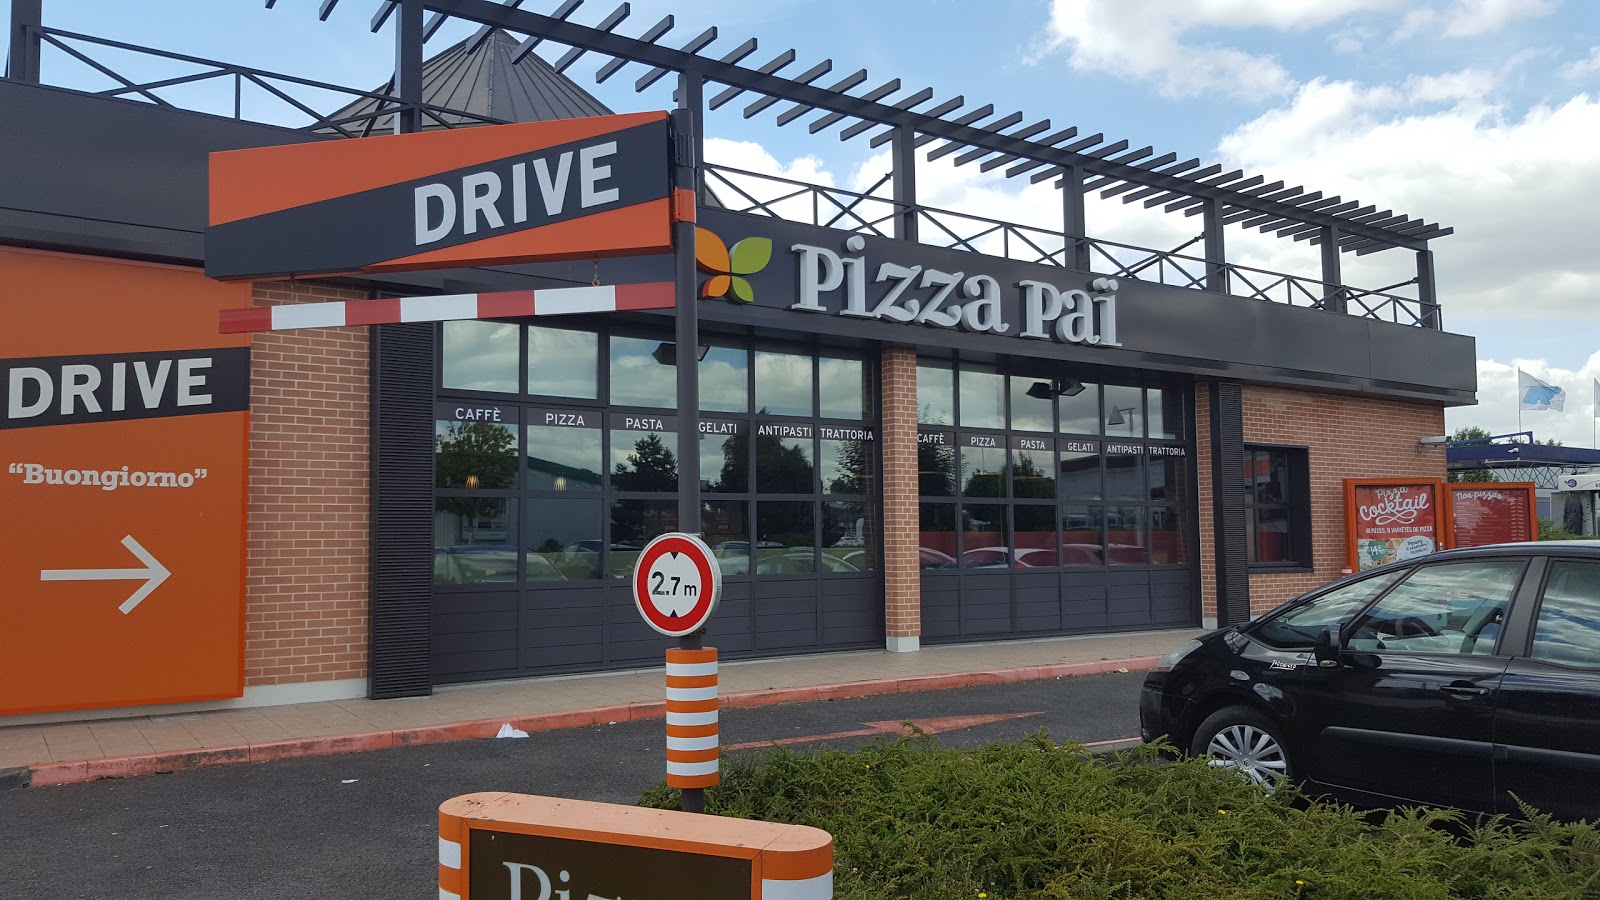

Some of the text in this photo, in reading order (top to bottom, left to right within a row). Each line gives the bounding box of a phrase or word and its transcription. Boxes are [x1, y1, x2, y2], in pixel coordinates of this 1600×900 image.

[414, 140, 620, 246] DRIVE
[790, 234, 1122, 348] Pizza Paï
[7, 357, 213, 420] DRIVE
[455, 406, 874, 441] CAFFÈ PIZZA PASTA GELATI ANTIPASTI TRATTORIA
[917, 432, 1186, 457] CAFFÈ PIZZA PASTA GELATI ANTIPASTI TRATTORIA
[1359, 493, 1430, 521] Cocktail
[1375, 486, 1408, 500] Pizza
[1455, 491, 1504, 501] Nos pizzas
